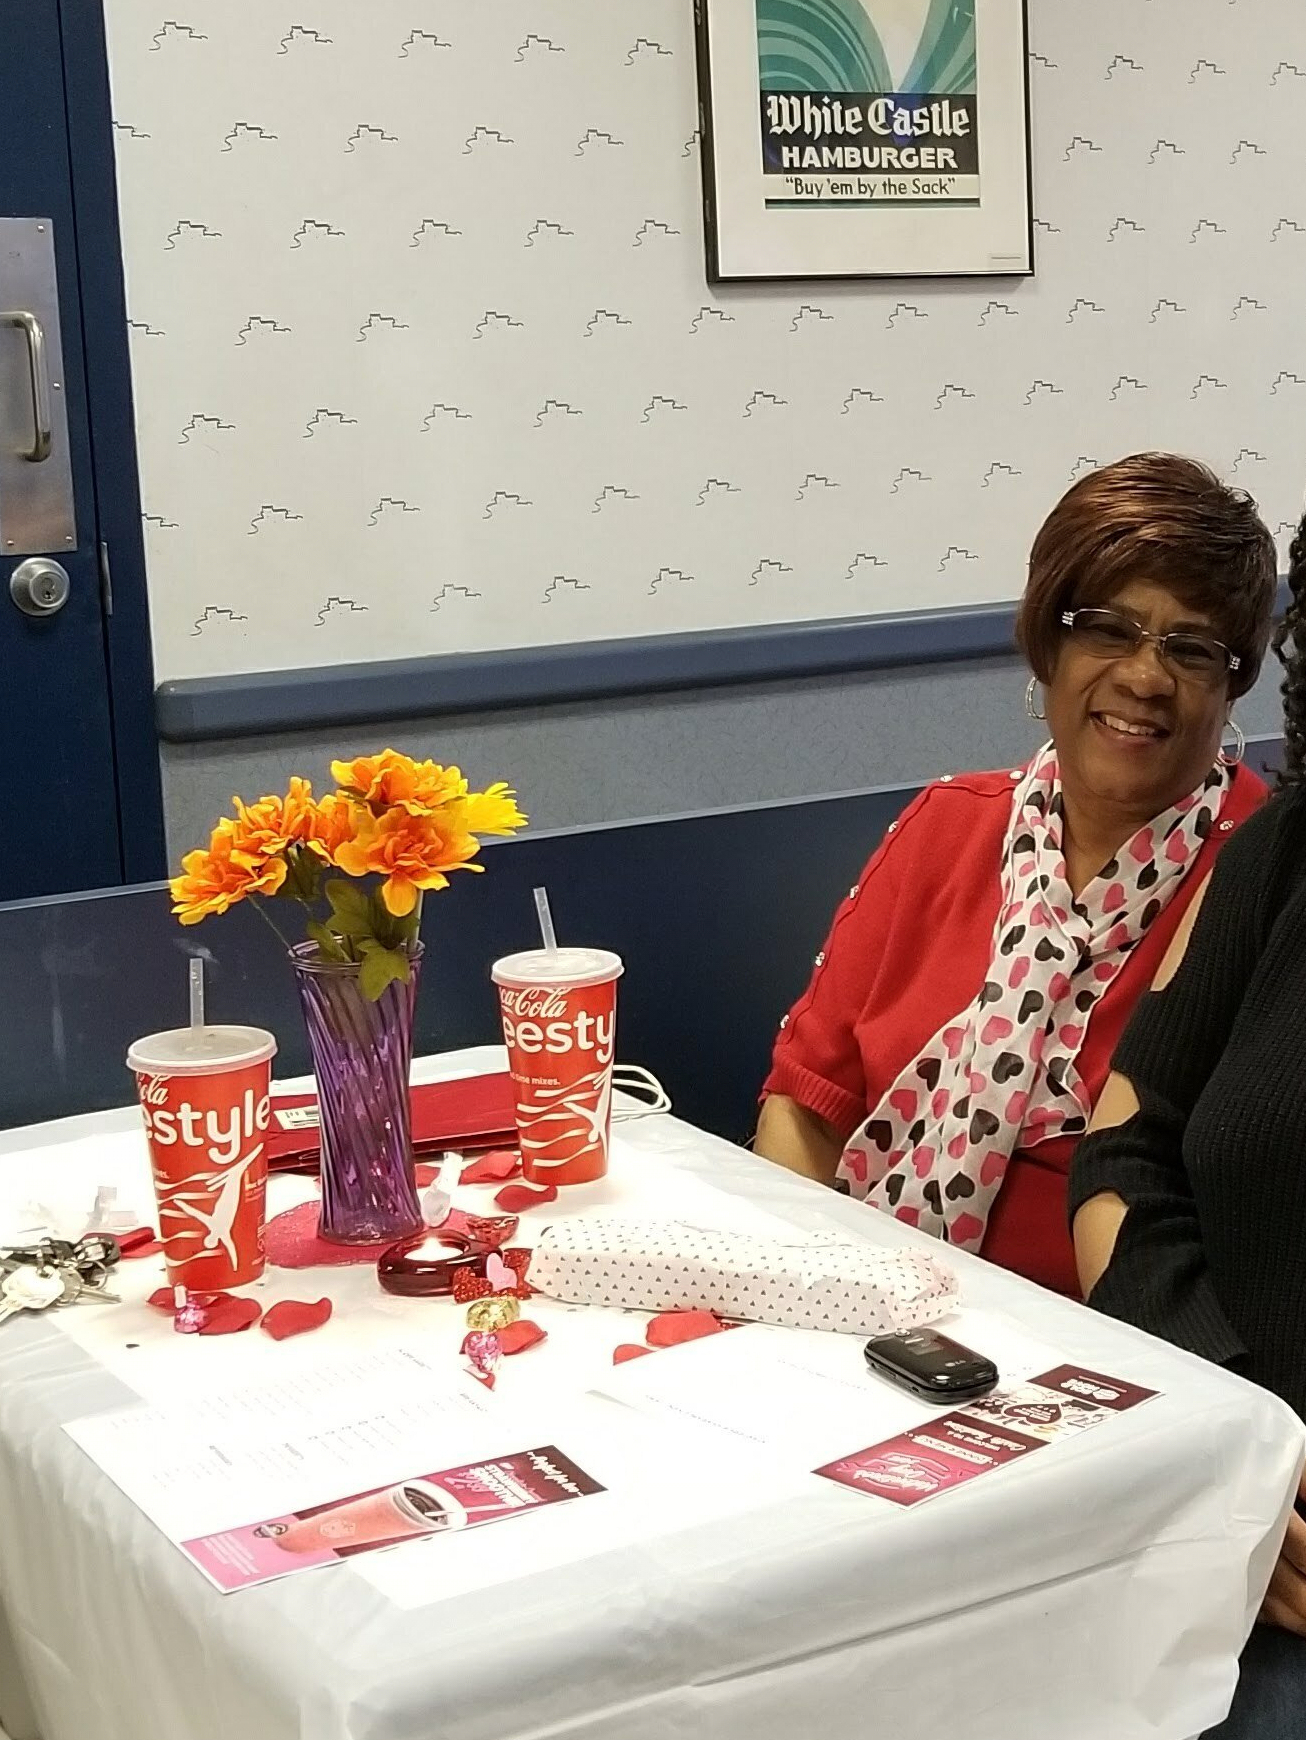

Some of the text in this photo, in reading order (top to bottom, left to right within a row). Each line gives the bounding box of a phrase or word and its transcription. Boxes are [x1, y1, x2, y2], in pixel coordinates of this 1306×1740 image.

[767, 95, 970, 140] White Castle
[782, 146, 958, 169] HAMBURGER
[857, 178, 877, 197] by
[882, 179, 907, 194] the
